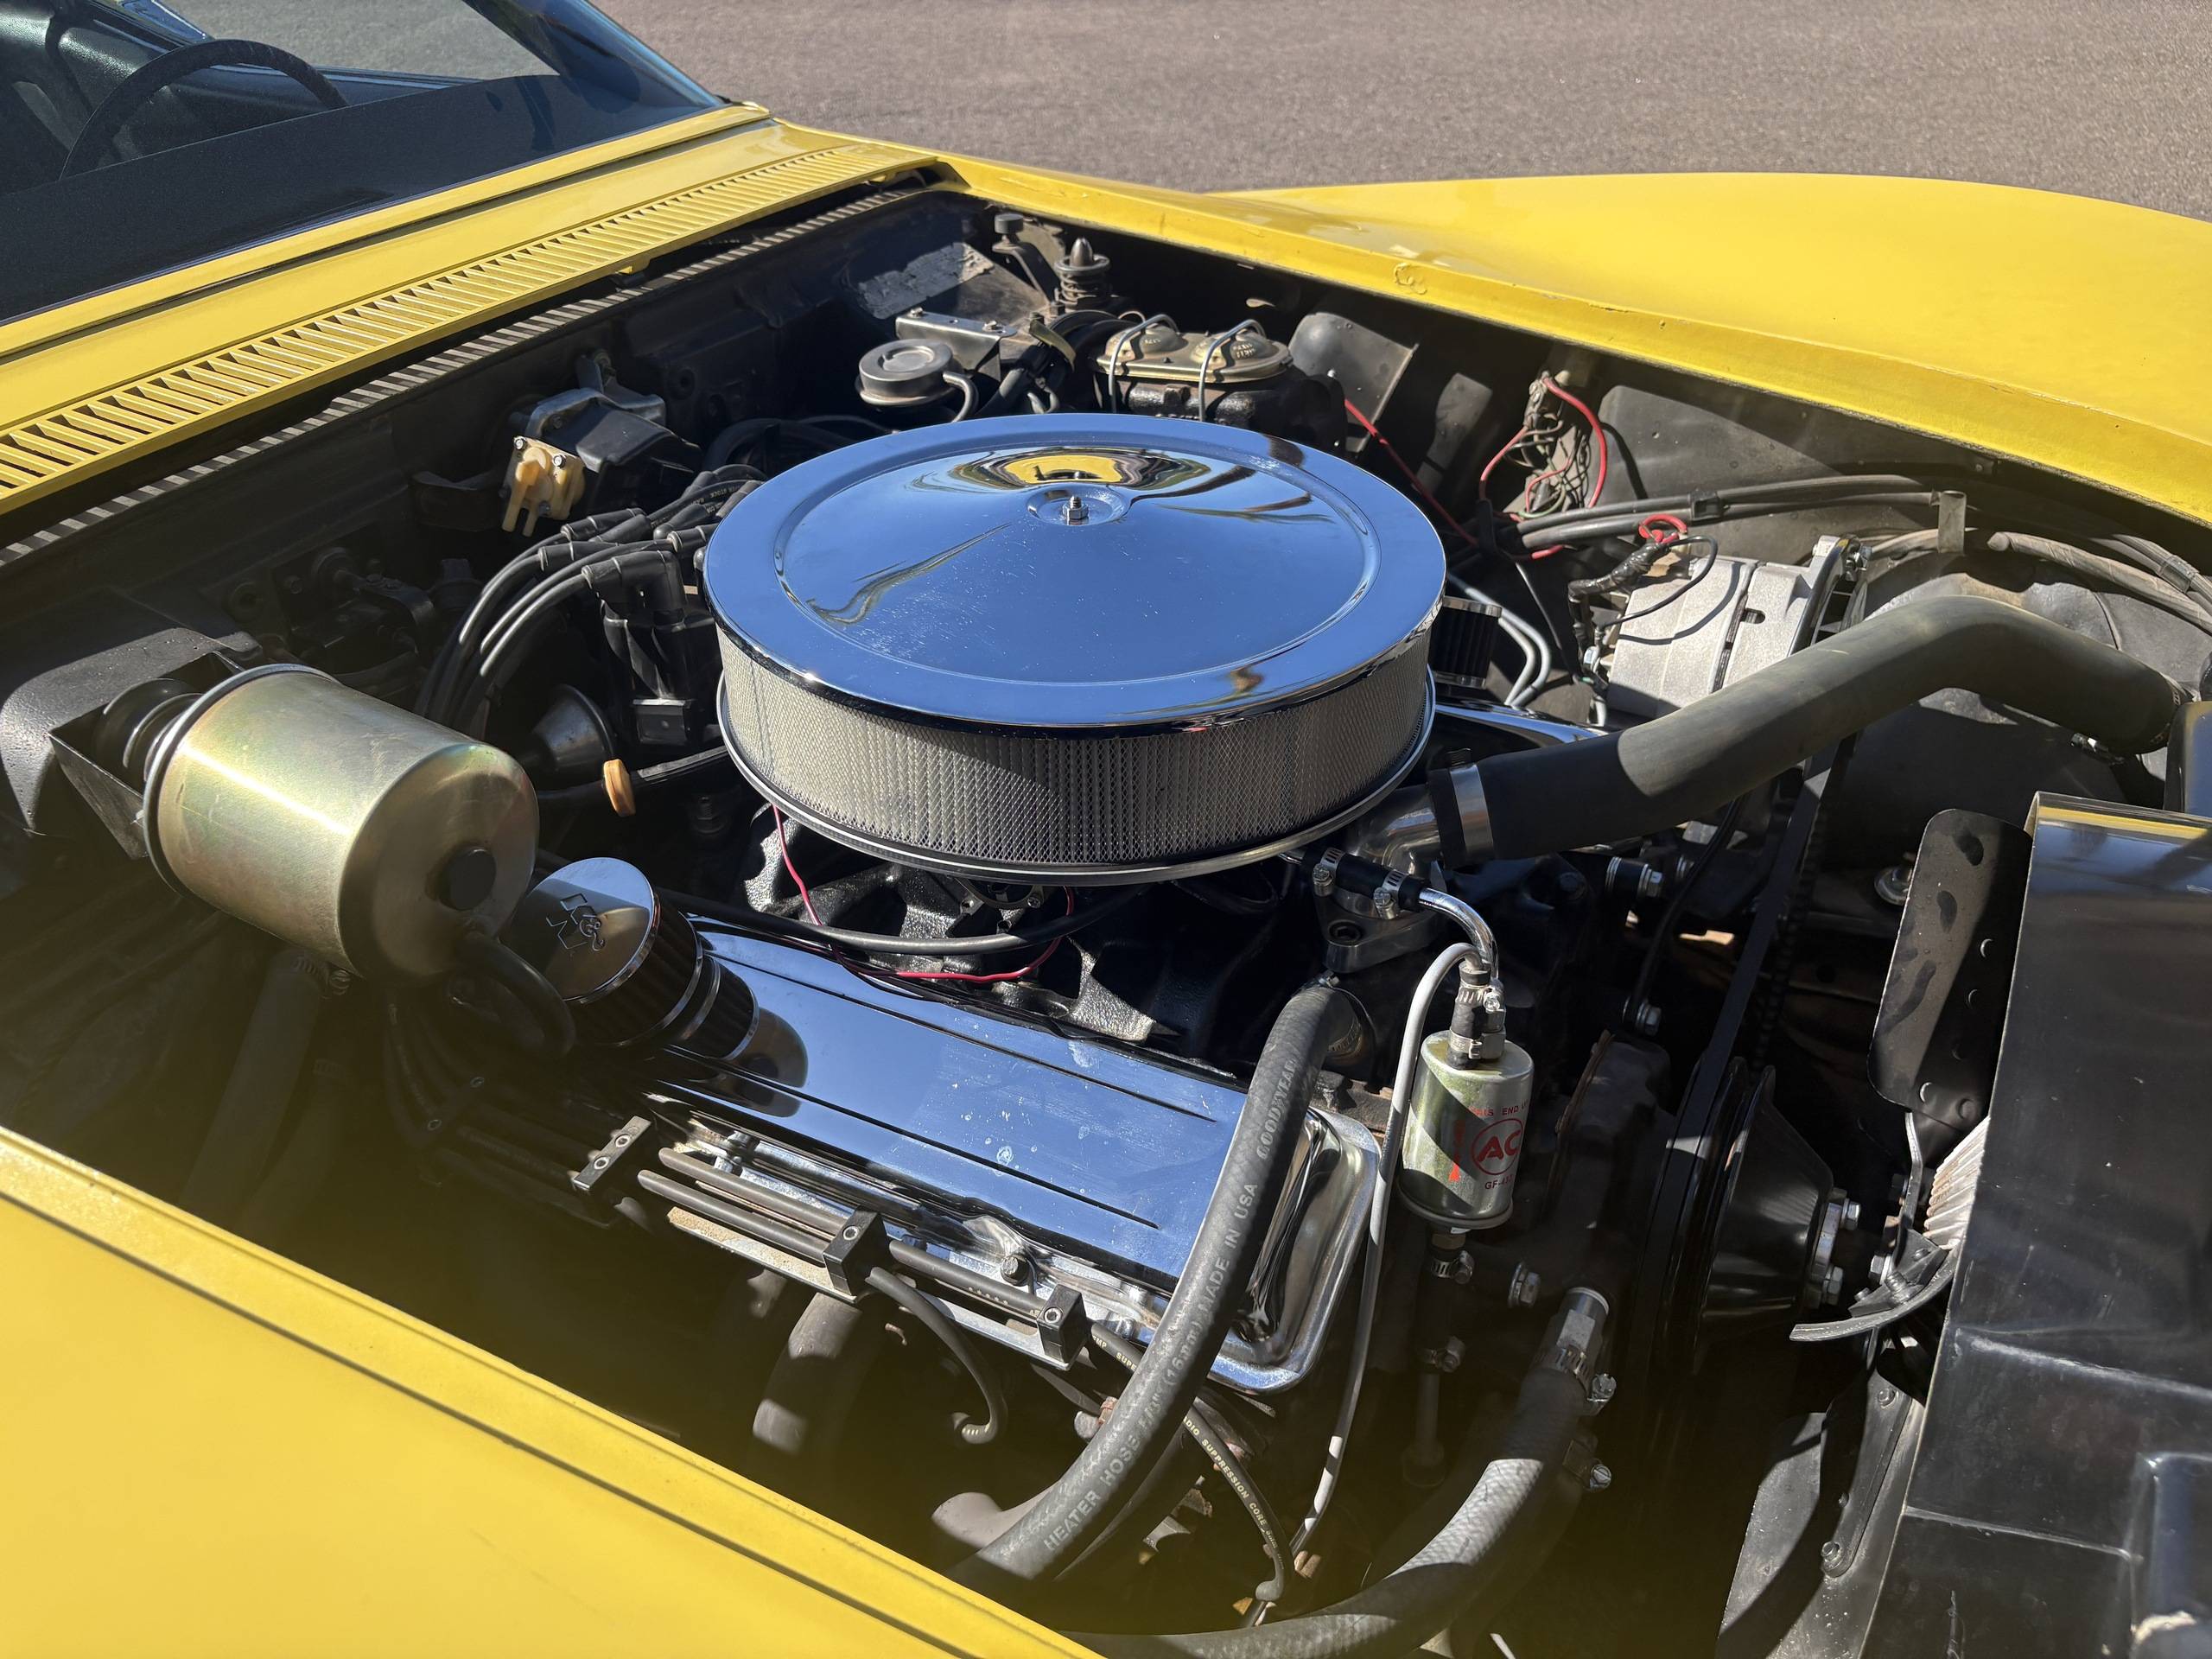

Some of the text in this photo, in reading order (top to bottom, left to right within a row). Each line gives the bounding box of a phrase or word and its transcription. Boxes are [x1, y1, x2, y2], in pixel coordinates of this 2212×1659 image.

[1502, 1105, 1519, 1116] END
[1478, 1129, 1522, 1162] AC
[1043, 1488, 1102, 1551] HEATER
[1099, 1433, 1141, 1488] HOSE
[1198, 1256, 1231, 1313] MADE
[1224, 1228, 1243, 1249] IN
[1234, 1184, 1258, 1220] USA
[1115, 1351, 1137, 1372] SUPE
[1201, 1439, 1250, 1499] SUPPRESSION
[1249, 1502, 1268, 1526] CORE
